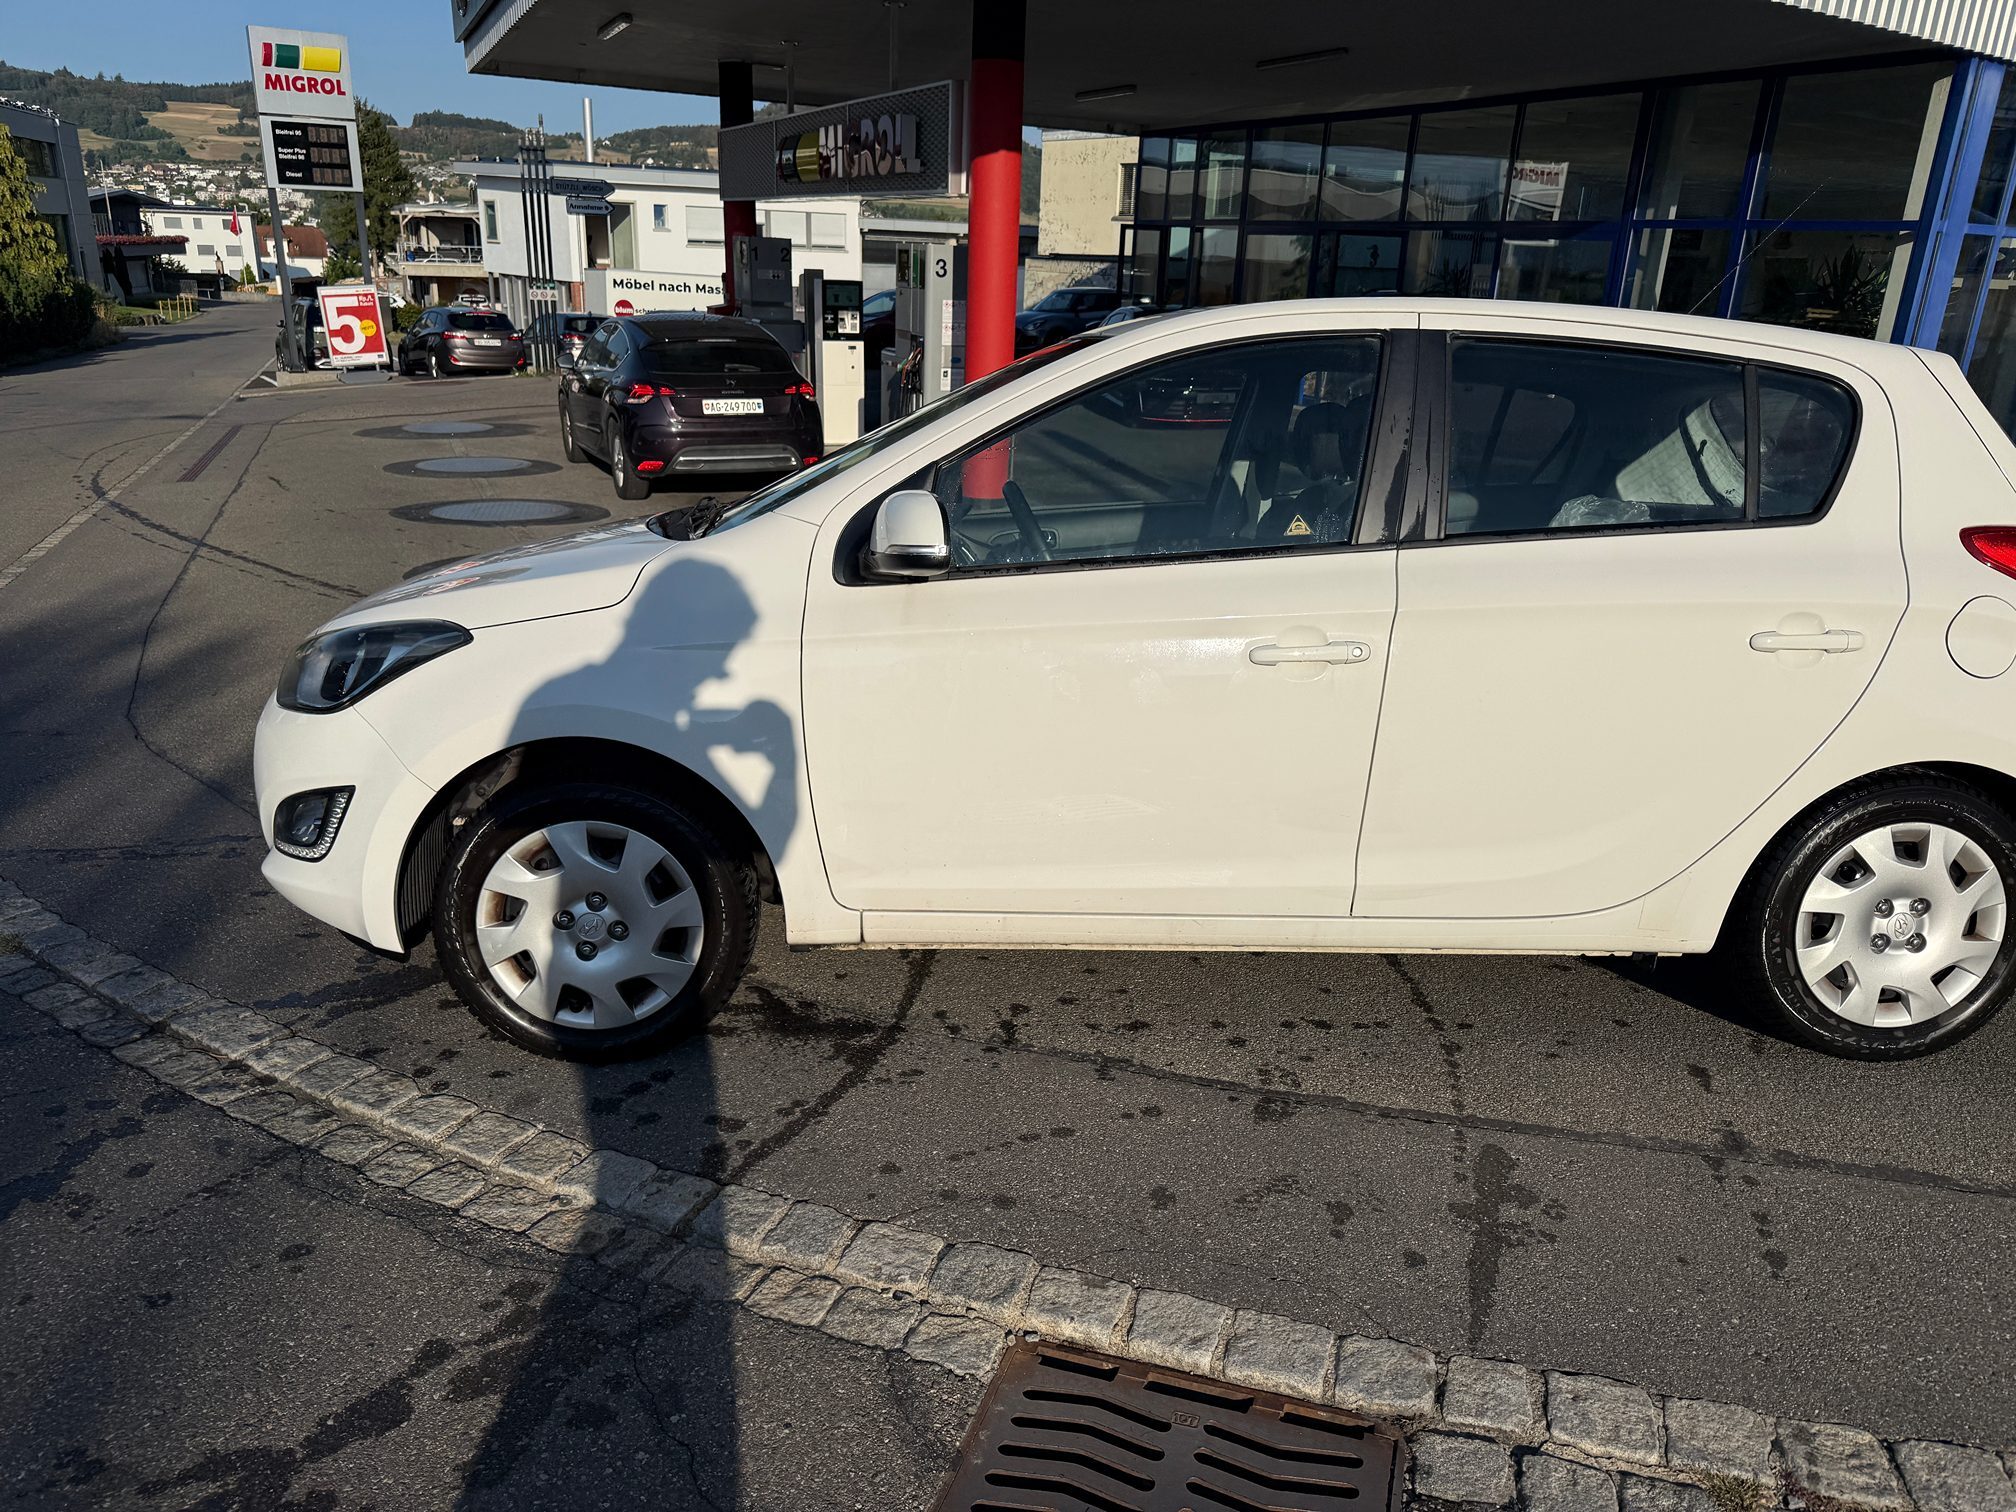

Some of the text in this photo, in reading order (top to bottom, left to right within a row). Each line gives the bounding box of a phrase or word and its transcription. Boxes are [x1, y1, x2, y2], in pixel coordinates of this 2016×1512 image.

[265, 73, 346, 96] MIGROL
[935, 258, 948, 278] 3
[612, 277, 655, 292] Möbel
[659, 282, 692, 295] nach
[615, 306, 634, 315] blum
[324, 296, 366, 354] 5
